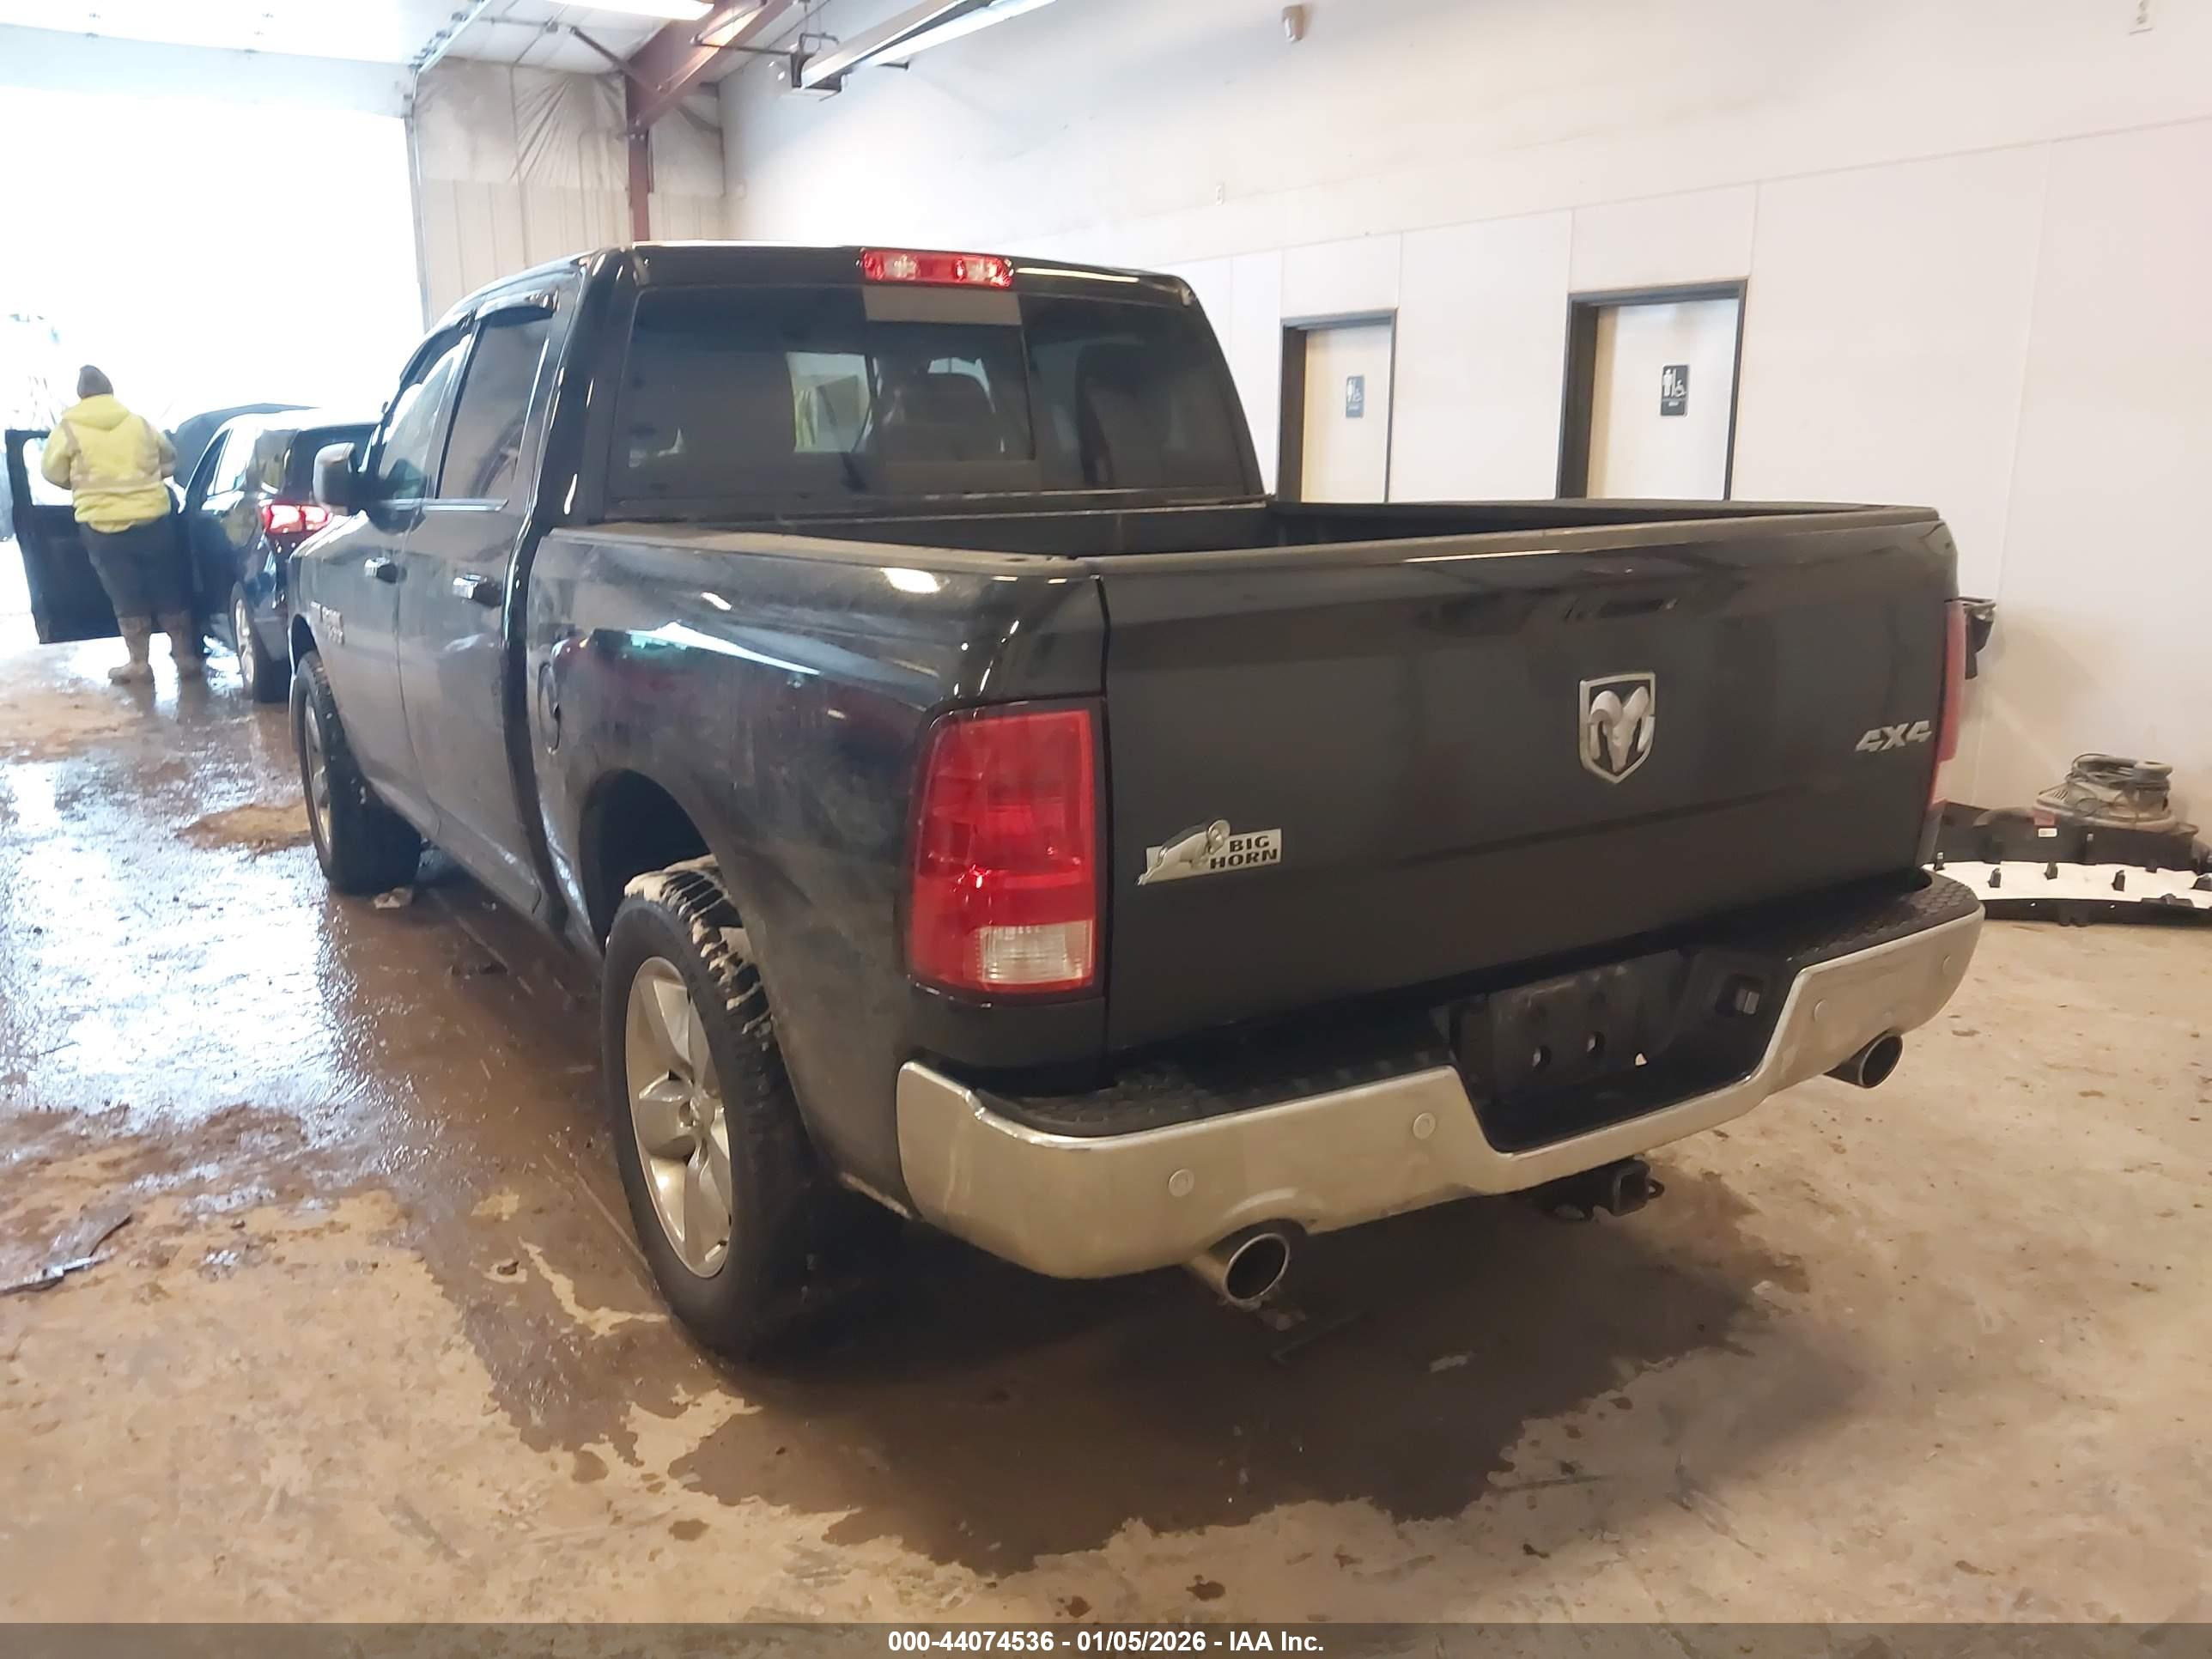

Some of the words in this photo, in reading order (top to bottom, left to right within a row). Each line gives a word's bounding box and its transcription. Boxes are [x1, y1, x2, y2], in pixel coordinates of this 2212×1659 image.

[1855, 720, 1932, 752] 4X4
[1229, 835, 1270, 853] BIG
[1209, 848, 1279, 870] HORN
